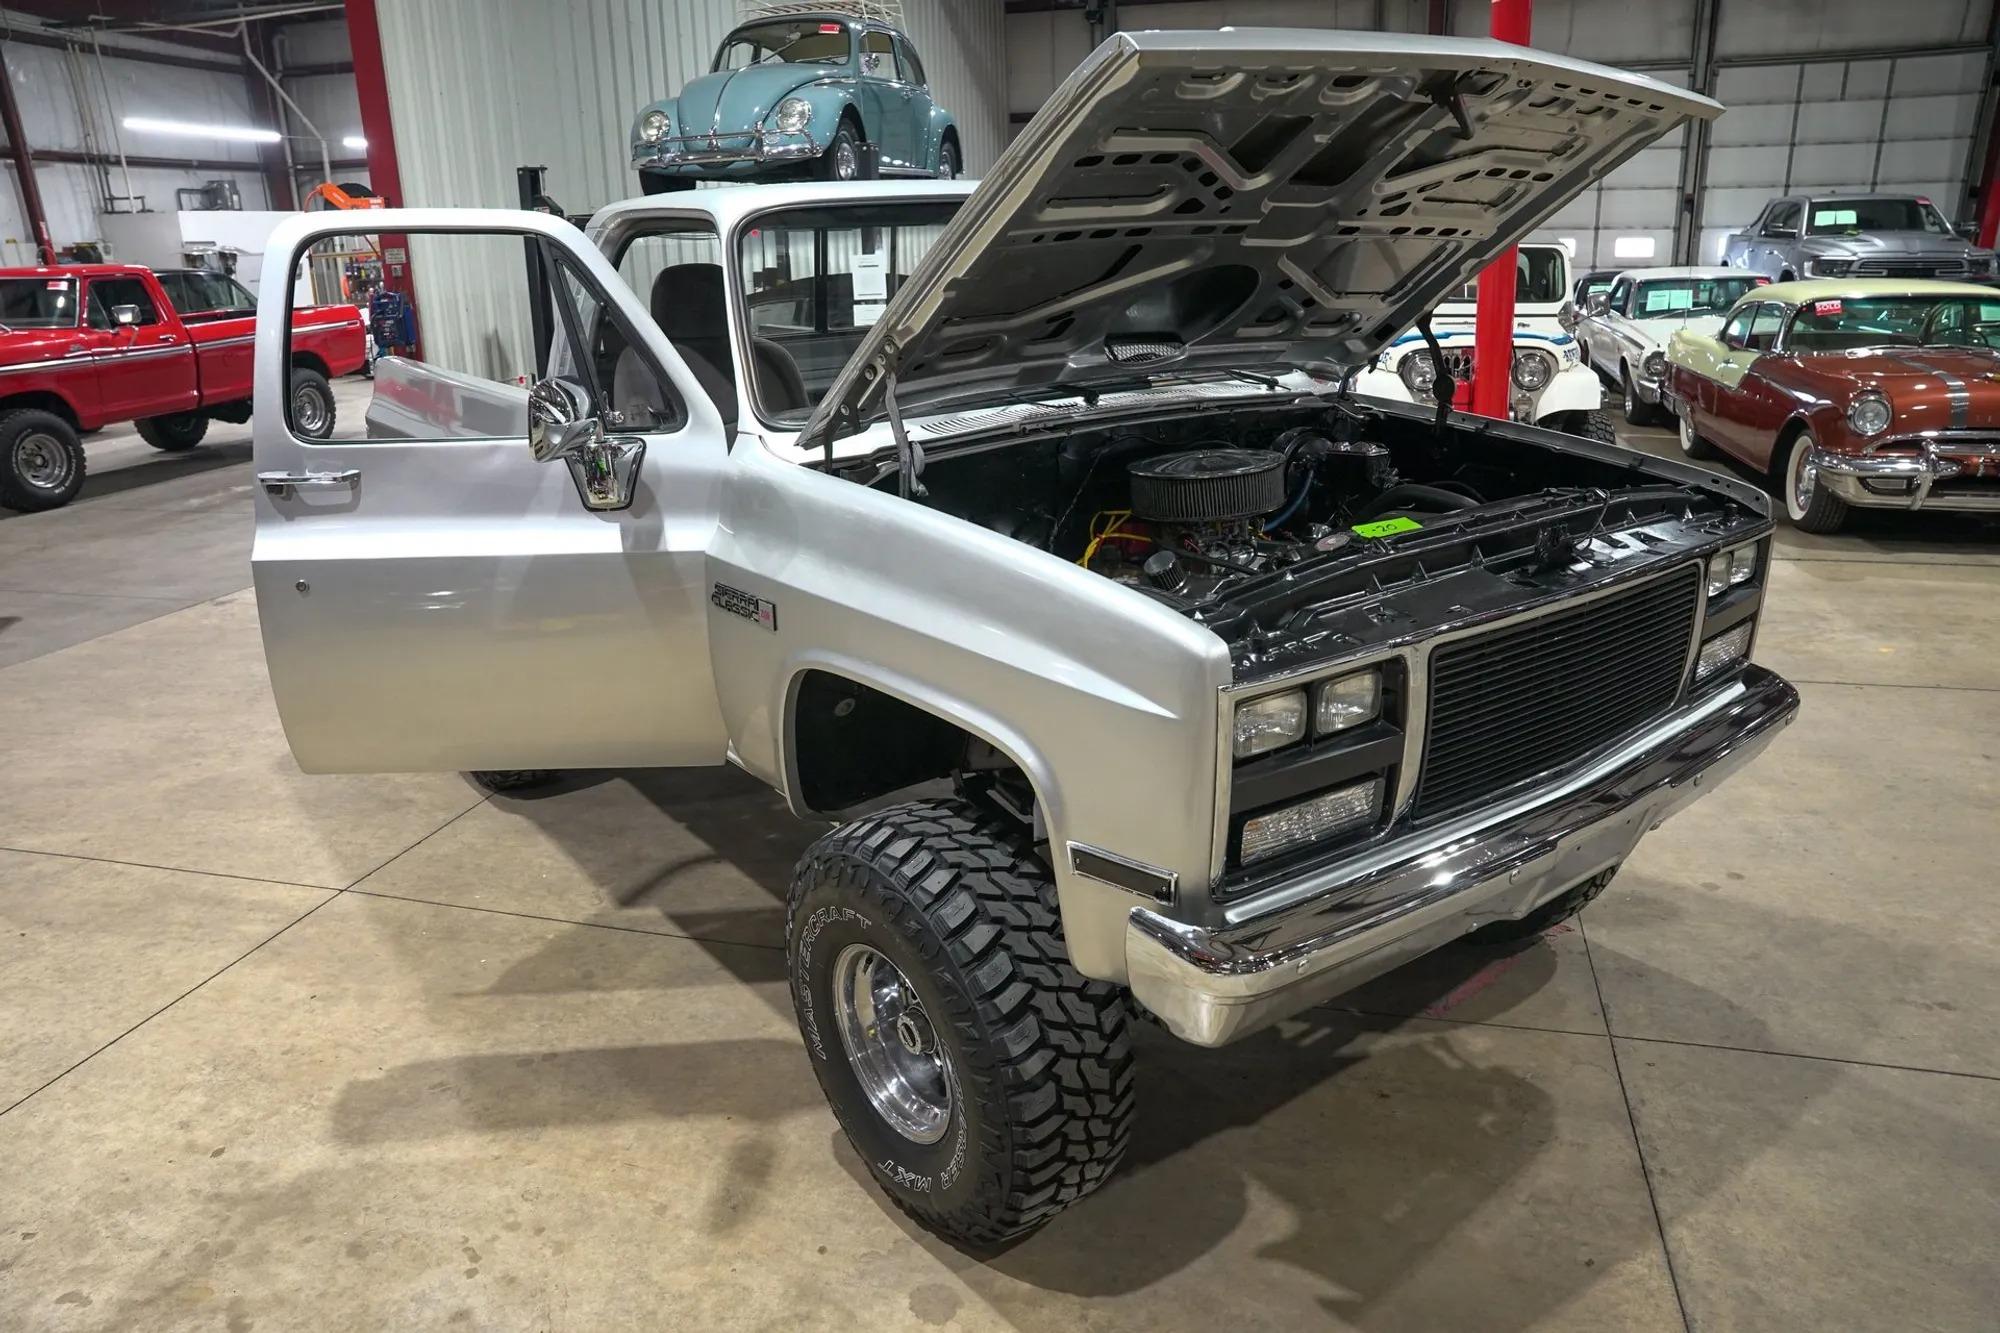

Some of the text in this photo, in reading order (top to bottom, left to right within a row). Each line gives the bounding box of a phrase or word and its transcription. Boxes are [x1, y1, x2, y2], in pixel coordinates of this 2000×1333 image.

[1816, 303, 1841, 312] SOLD
[799, 906, 872, 1061] MASTERCRAFT
[877, 1159, 933, 1193] MXT
